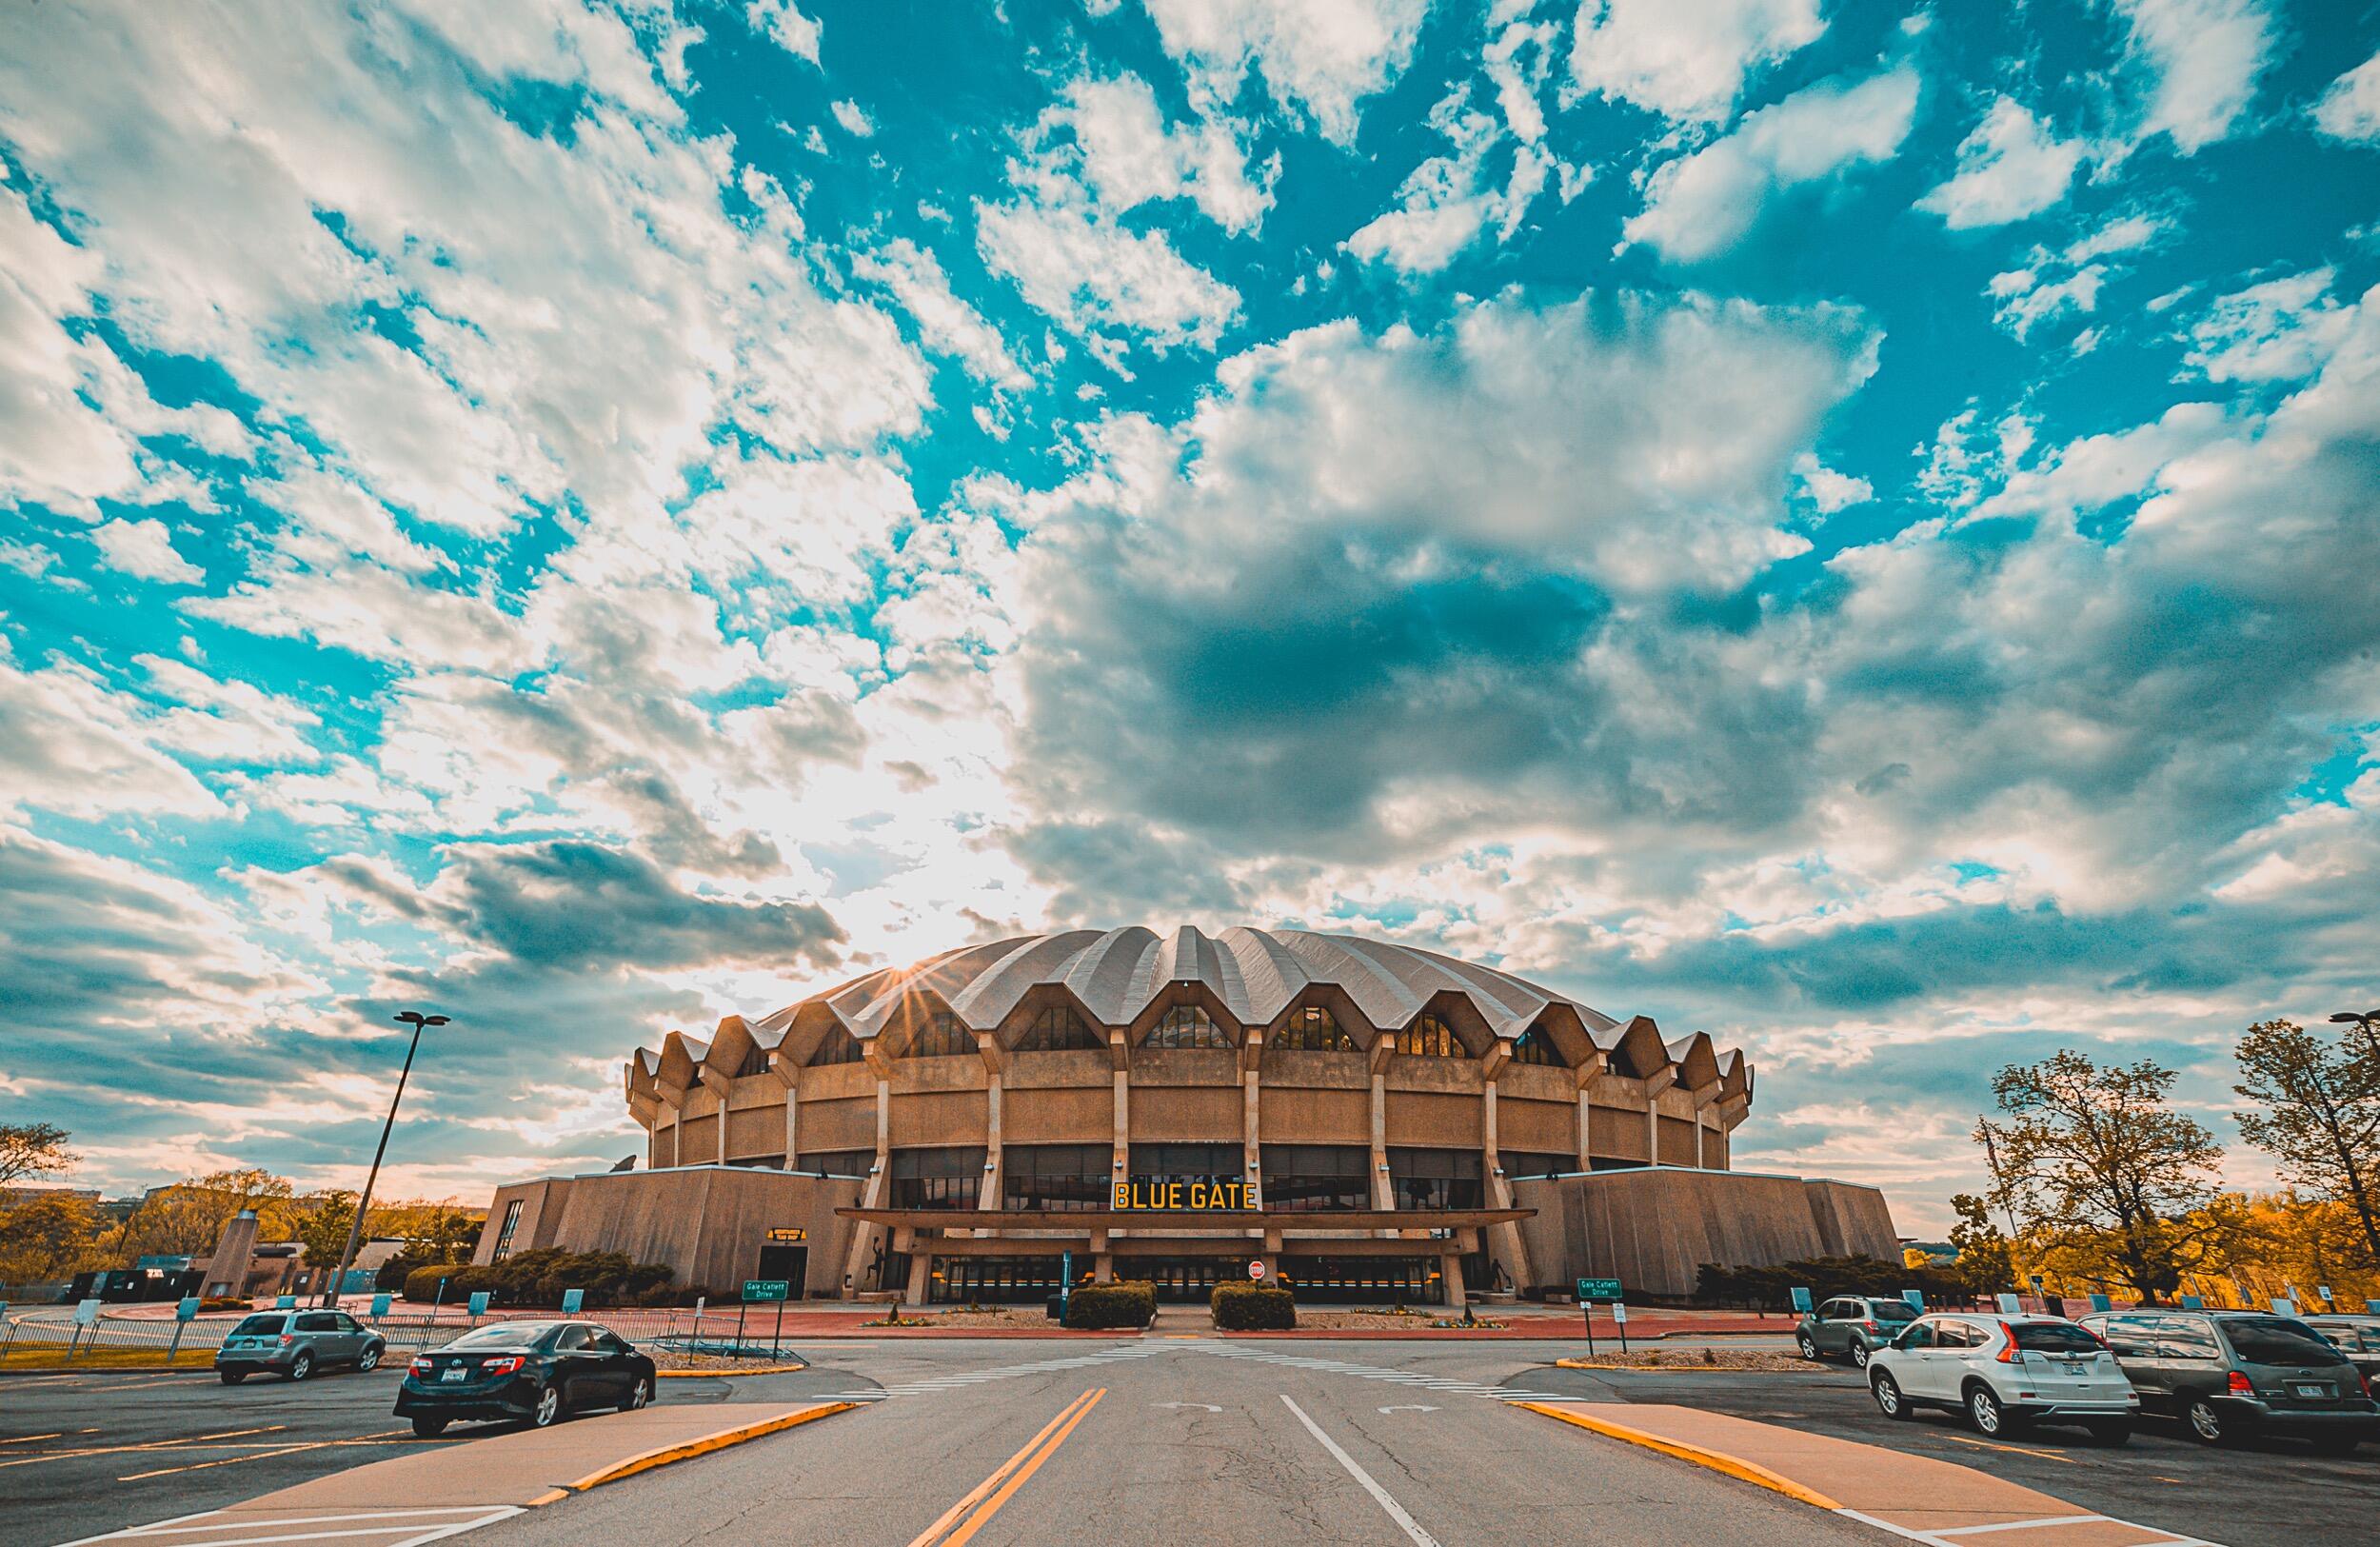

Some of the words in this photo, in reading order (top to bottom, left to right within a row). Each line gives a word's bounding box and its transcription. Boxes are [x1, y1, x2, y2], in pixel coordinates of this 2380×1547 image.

[1115, 1183, 1182, 1209] BLUE
[1191, 1183, 1257, 1209] GATE
[1249, 1265, 1264, 1274] STOP
[762, 1282, 784, 1291] Catlett
